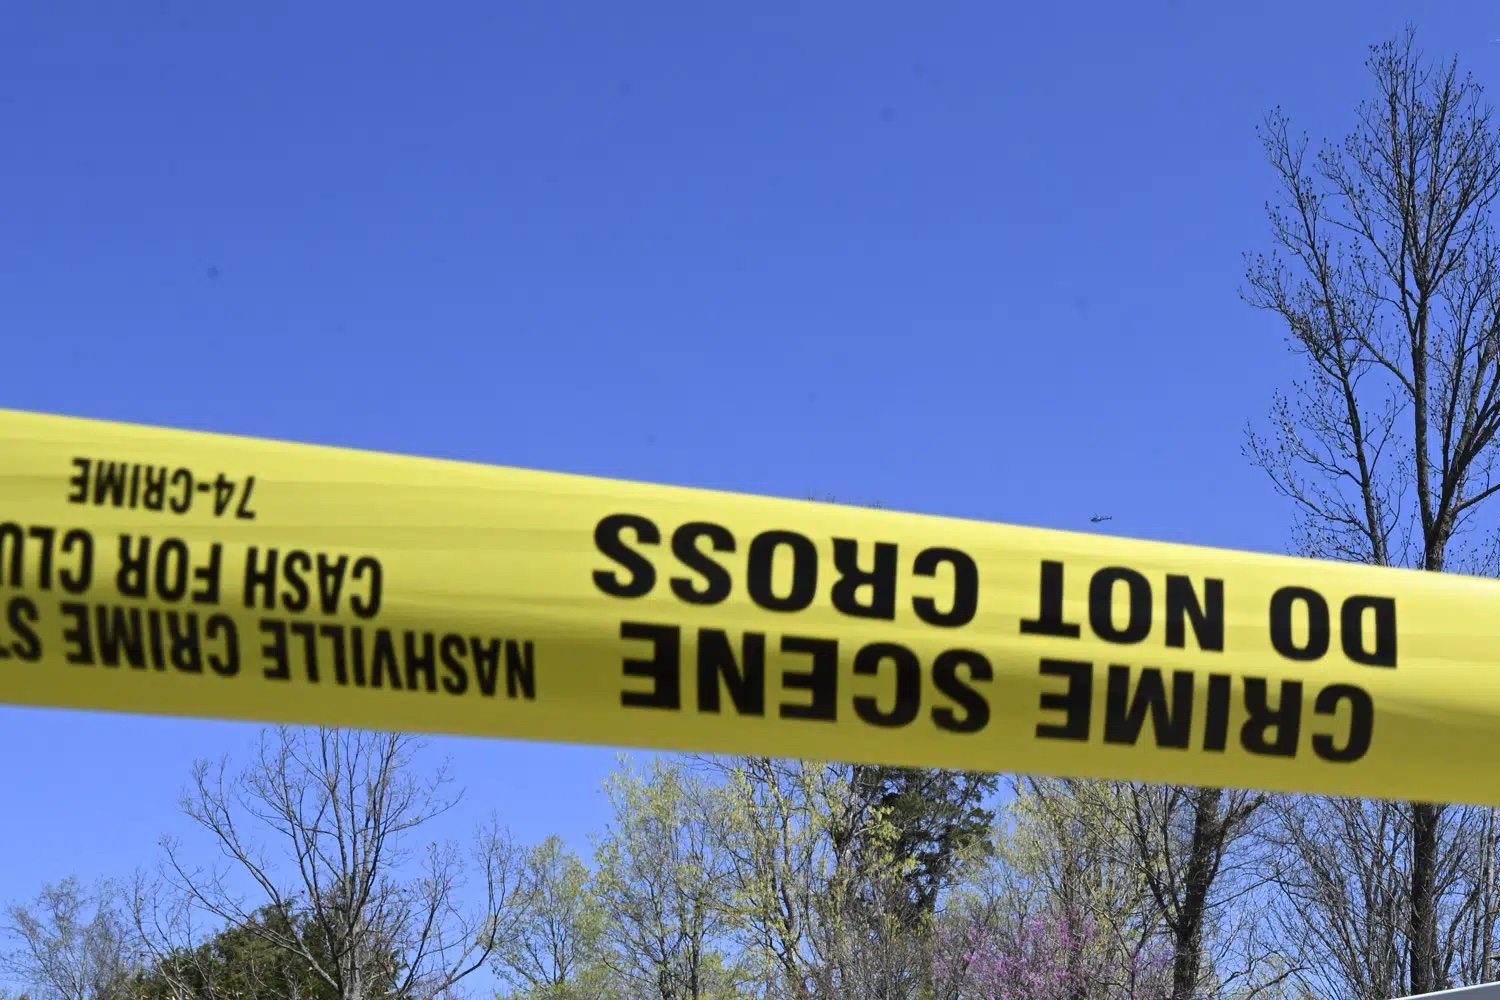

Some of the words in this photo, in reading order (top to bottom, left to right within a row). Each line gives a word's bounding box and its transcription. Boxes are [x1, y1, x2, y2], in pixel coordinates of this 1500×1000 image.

[68, 457, 256, 520] 74-CRIME
[116, 533, 223, 606] FOR
[243, 546, 383, 620] CASH
[591, 513, 980, 629] CROSS
[1018, 559, 1225, 653] NOT
[60, 601, 241, 678] CRIME
[259, 618, 537, 701] NASHVILLE
[1268, 585, 1398, 670] DO
[620, 620, 994, 734] SCENE
[1035, 657, 1375, 764] CRIME
